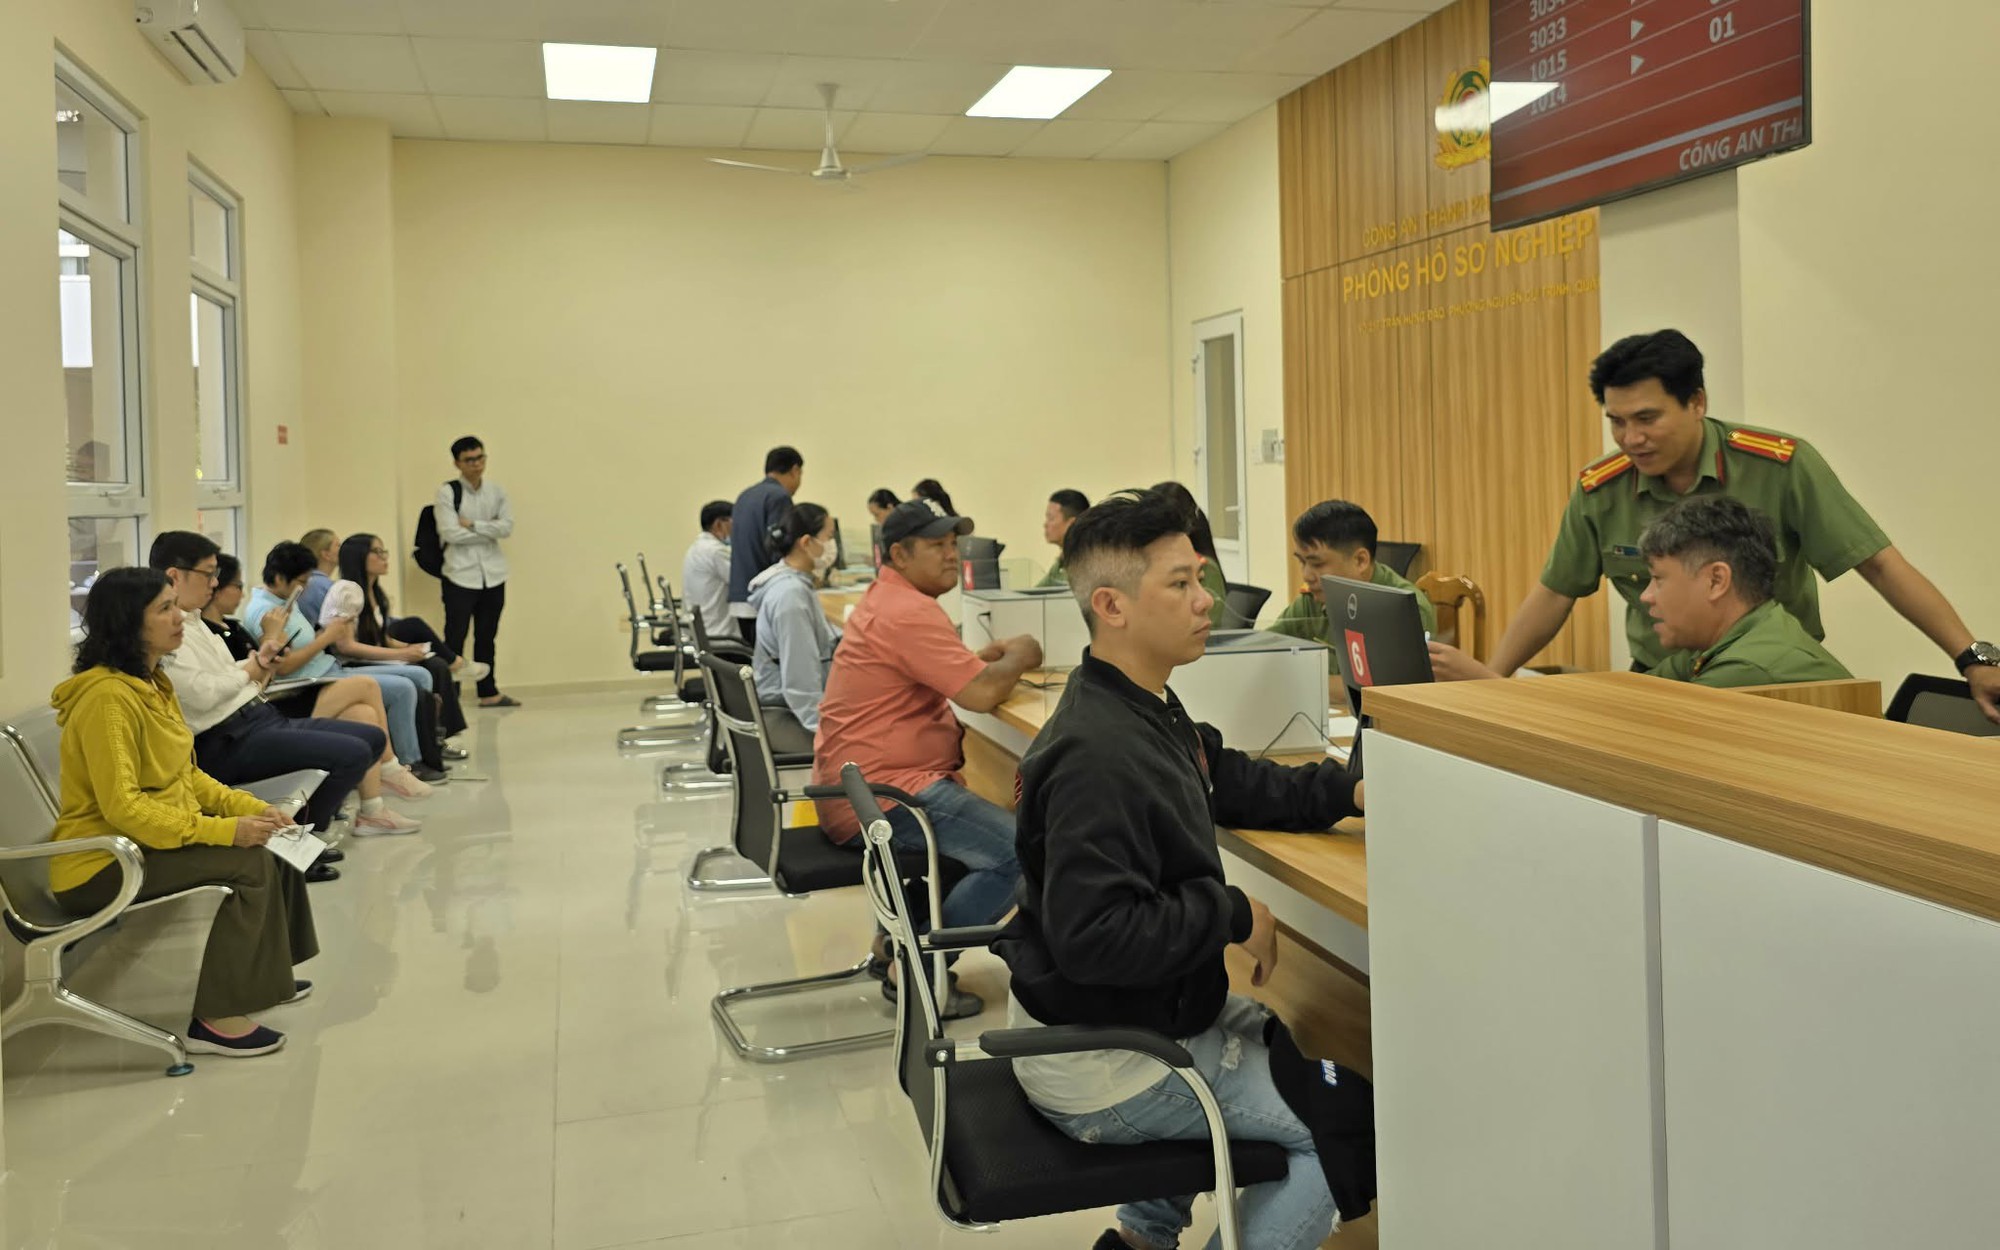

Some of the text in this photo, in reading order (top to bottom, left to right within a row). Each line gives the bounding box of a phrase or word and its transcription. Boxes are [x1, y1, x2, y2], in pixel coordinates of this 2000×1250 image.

[1529, 16, 1567, 53] 3033
[1709, 10, 1735, 43] 01
[1530, 48, 1567, 82] 1015
[1679, 136, 1731, 171] CÔNG
[1734, 126, 1765, 156] AN
[1343, 259, 1409, 304] PHÒNG
[1351, 640, 1364, 678] 6
